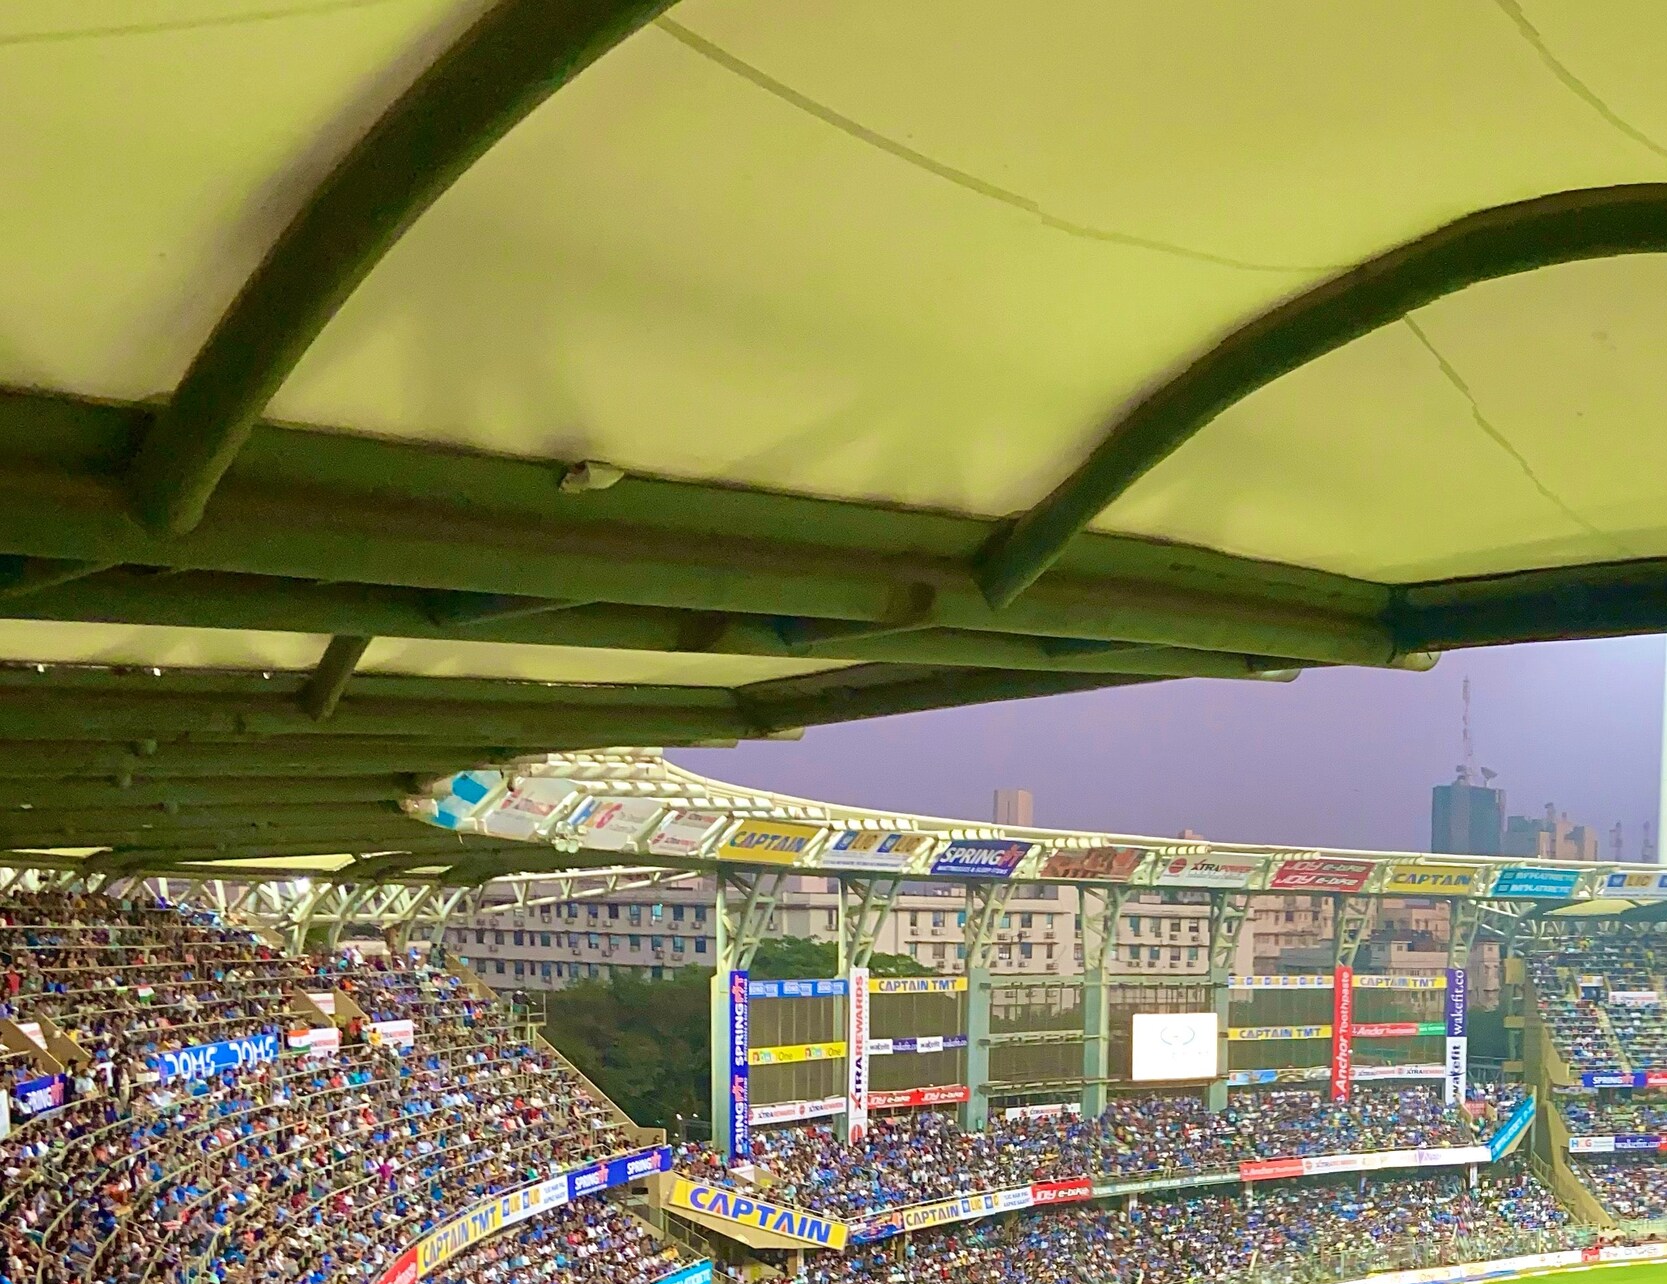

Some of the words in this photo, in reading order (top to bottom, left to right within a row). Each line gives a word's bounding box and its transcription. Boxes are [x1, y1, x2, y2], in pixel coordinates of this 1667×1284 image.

[729, 830, 807, 853] CAPTAIN
[1275, 875, 1316, 886] JOY
[1392, 872, 1472, 887] CAPTAIN
[878, 979, 928, 992] CAPTAIN
[932, 978, 957, 991] TMT
[1359, 976, 1408, 988] CAPTAIN
[1411, 977, 1436, 987] TMT
[1338, 970, 1350, 1036] Toothpaste
[1450, 969, 1466, 1036] wakefit.co
[851, 974, 864, 1110] XTRAREWARDS
[1239, 1027, 1293, 1039] CAPTAIN
[1296, 1027, 1321, 1037] TMT
[164, 1046, 216, 1083] DOMS
[229, 1037, 276, 1068] DOMS
[1334, 1036, 1350, 1093] Anchor
[1035, 1188, 1057, 1201] JOY
[689, 1187, 831, 1244] CAPTAIN
[904, 1206, 959, 1226] CAPTAIN
[423, 1222, 470, 1267] CAPTAIN
[471, 1206, 497, 1237] TMT
